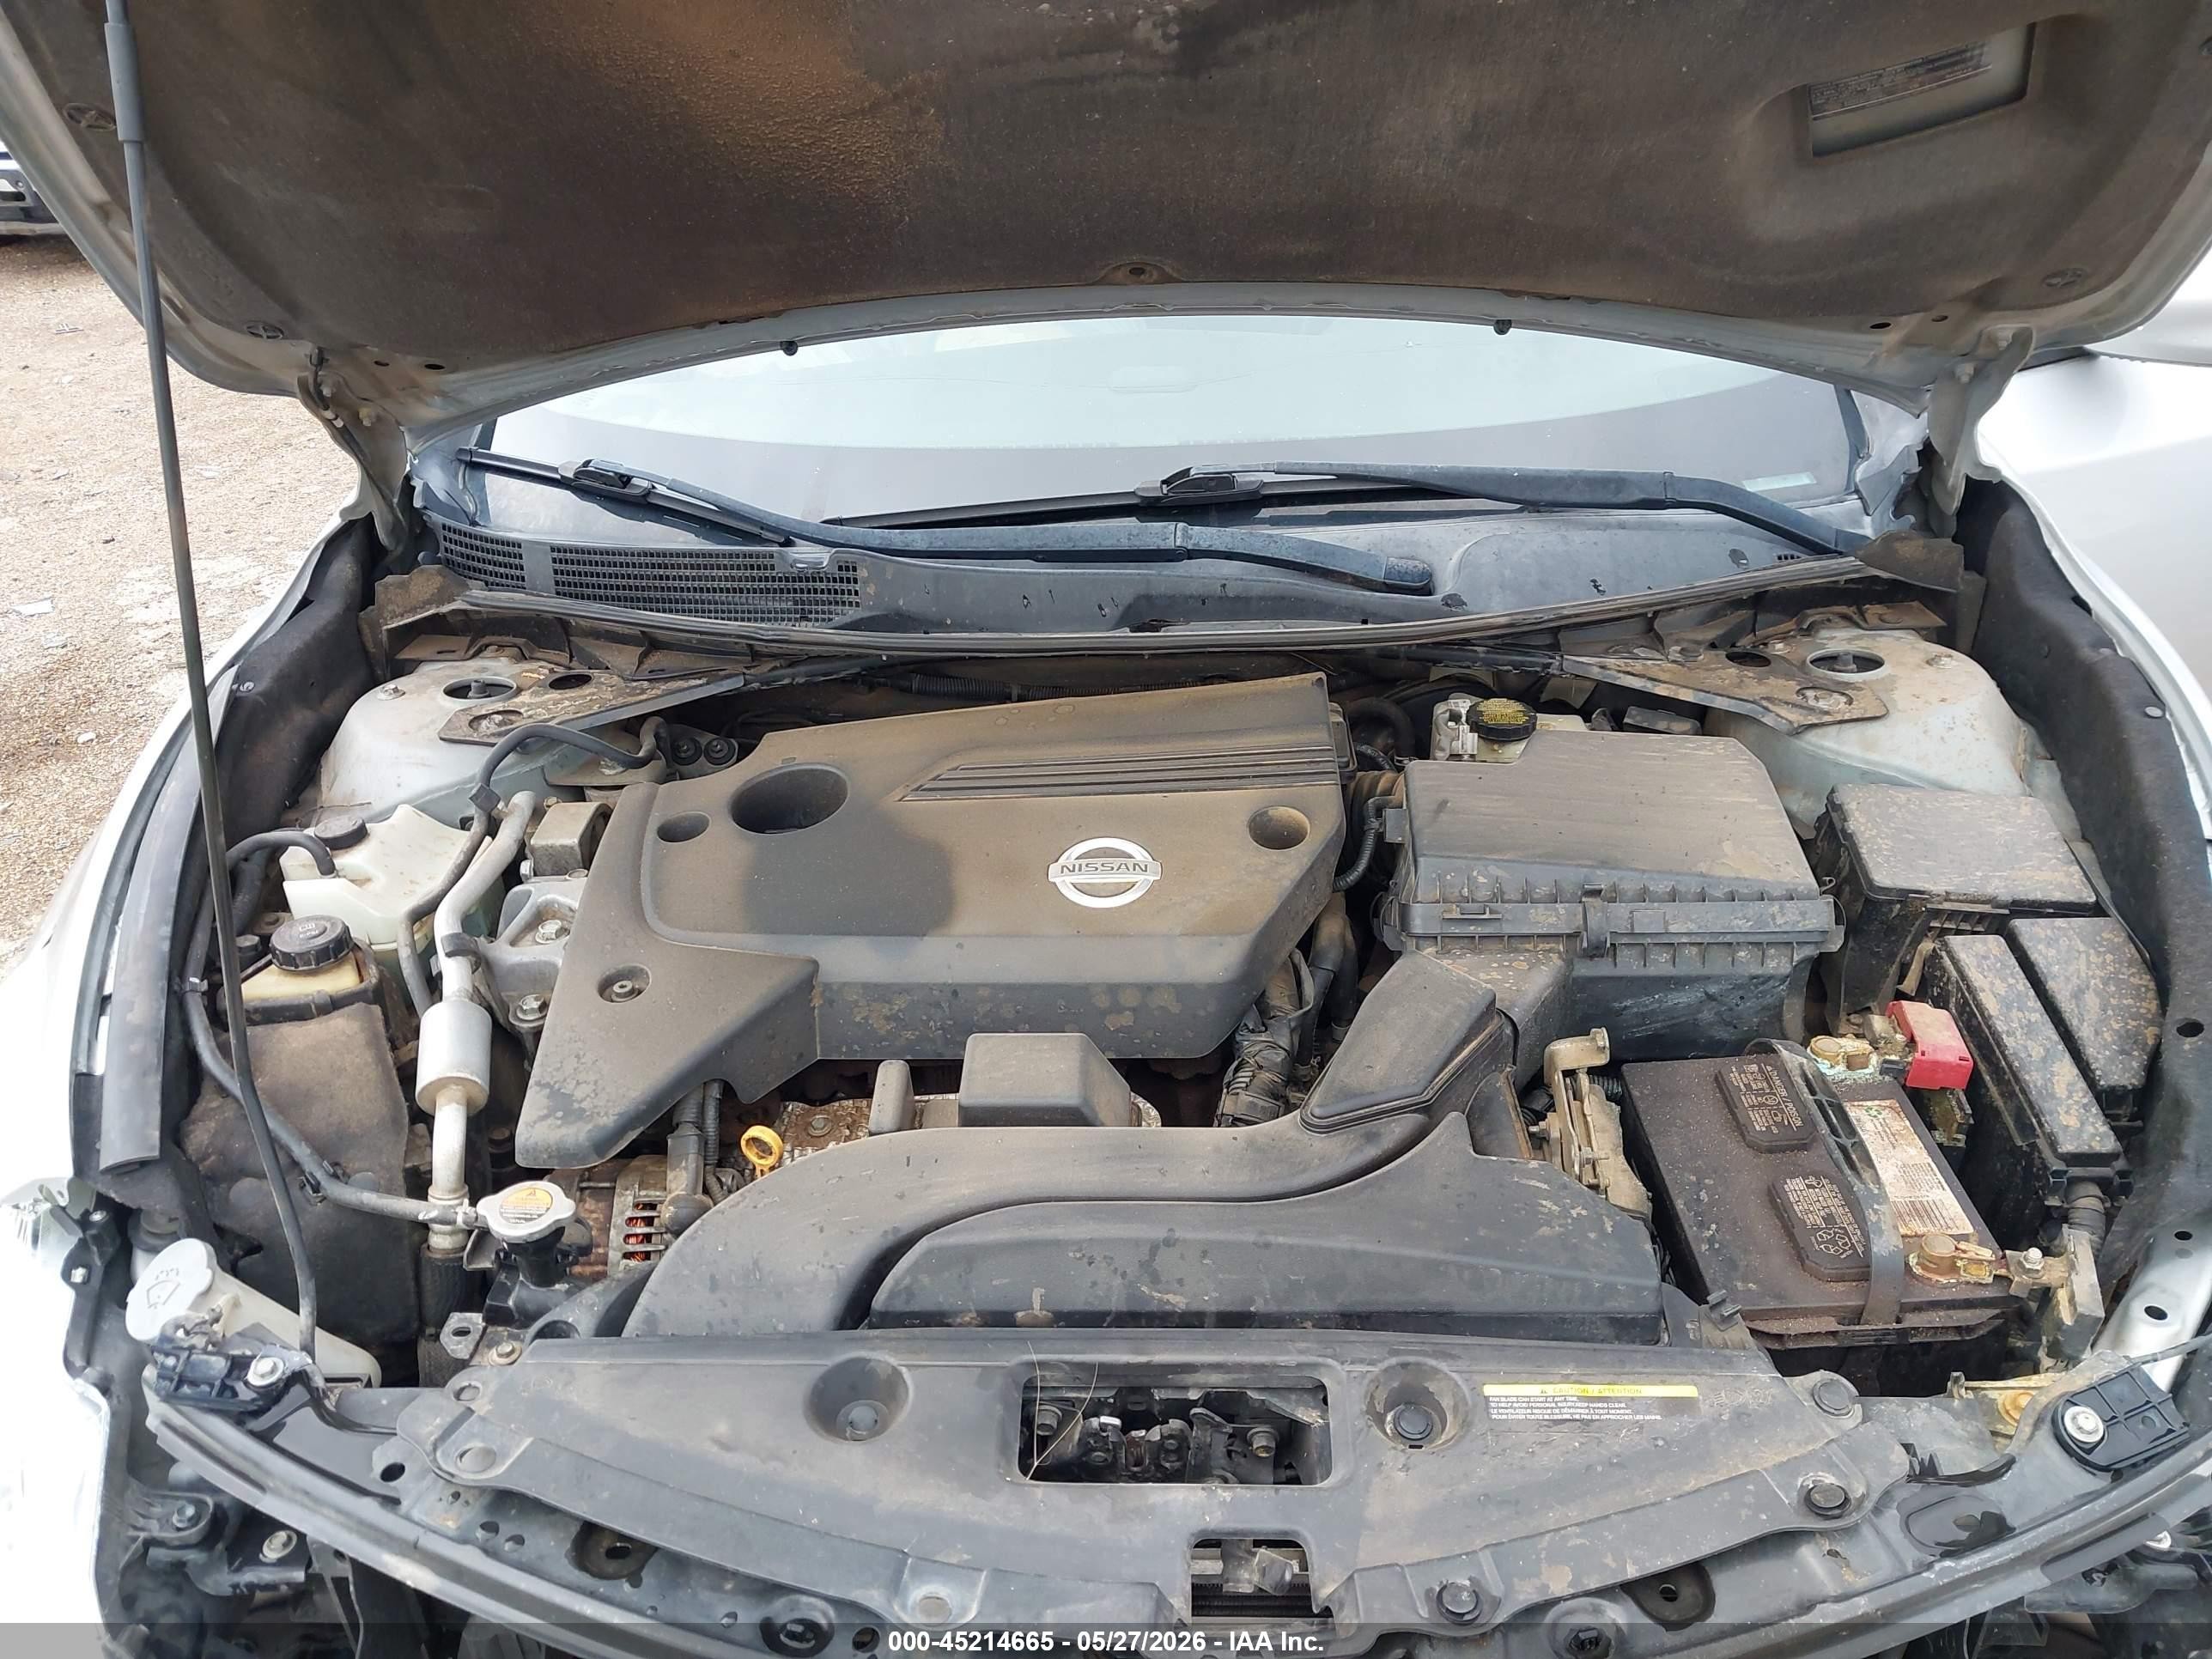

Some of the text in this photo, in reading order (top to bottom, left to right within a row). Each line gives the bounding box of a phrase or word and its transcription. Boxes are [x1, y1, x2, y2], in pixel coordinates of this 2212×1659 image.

[1060, 862, 1149, 874] NISSAN
[1769, 1071, 1788, 1097] DANGER
[1784, 1103, 1803, 1127] POISON
